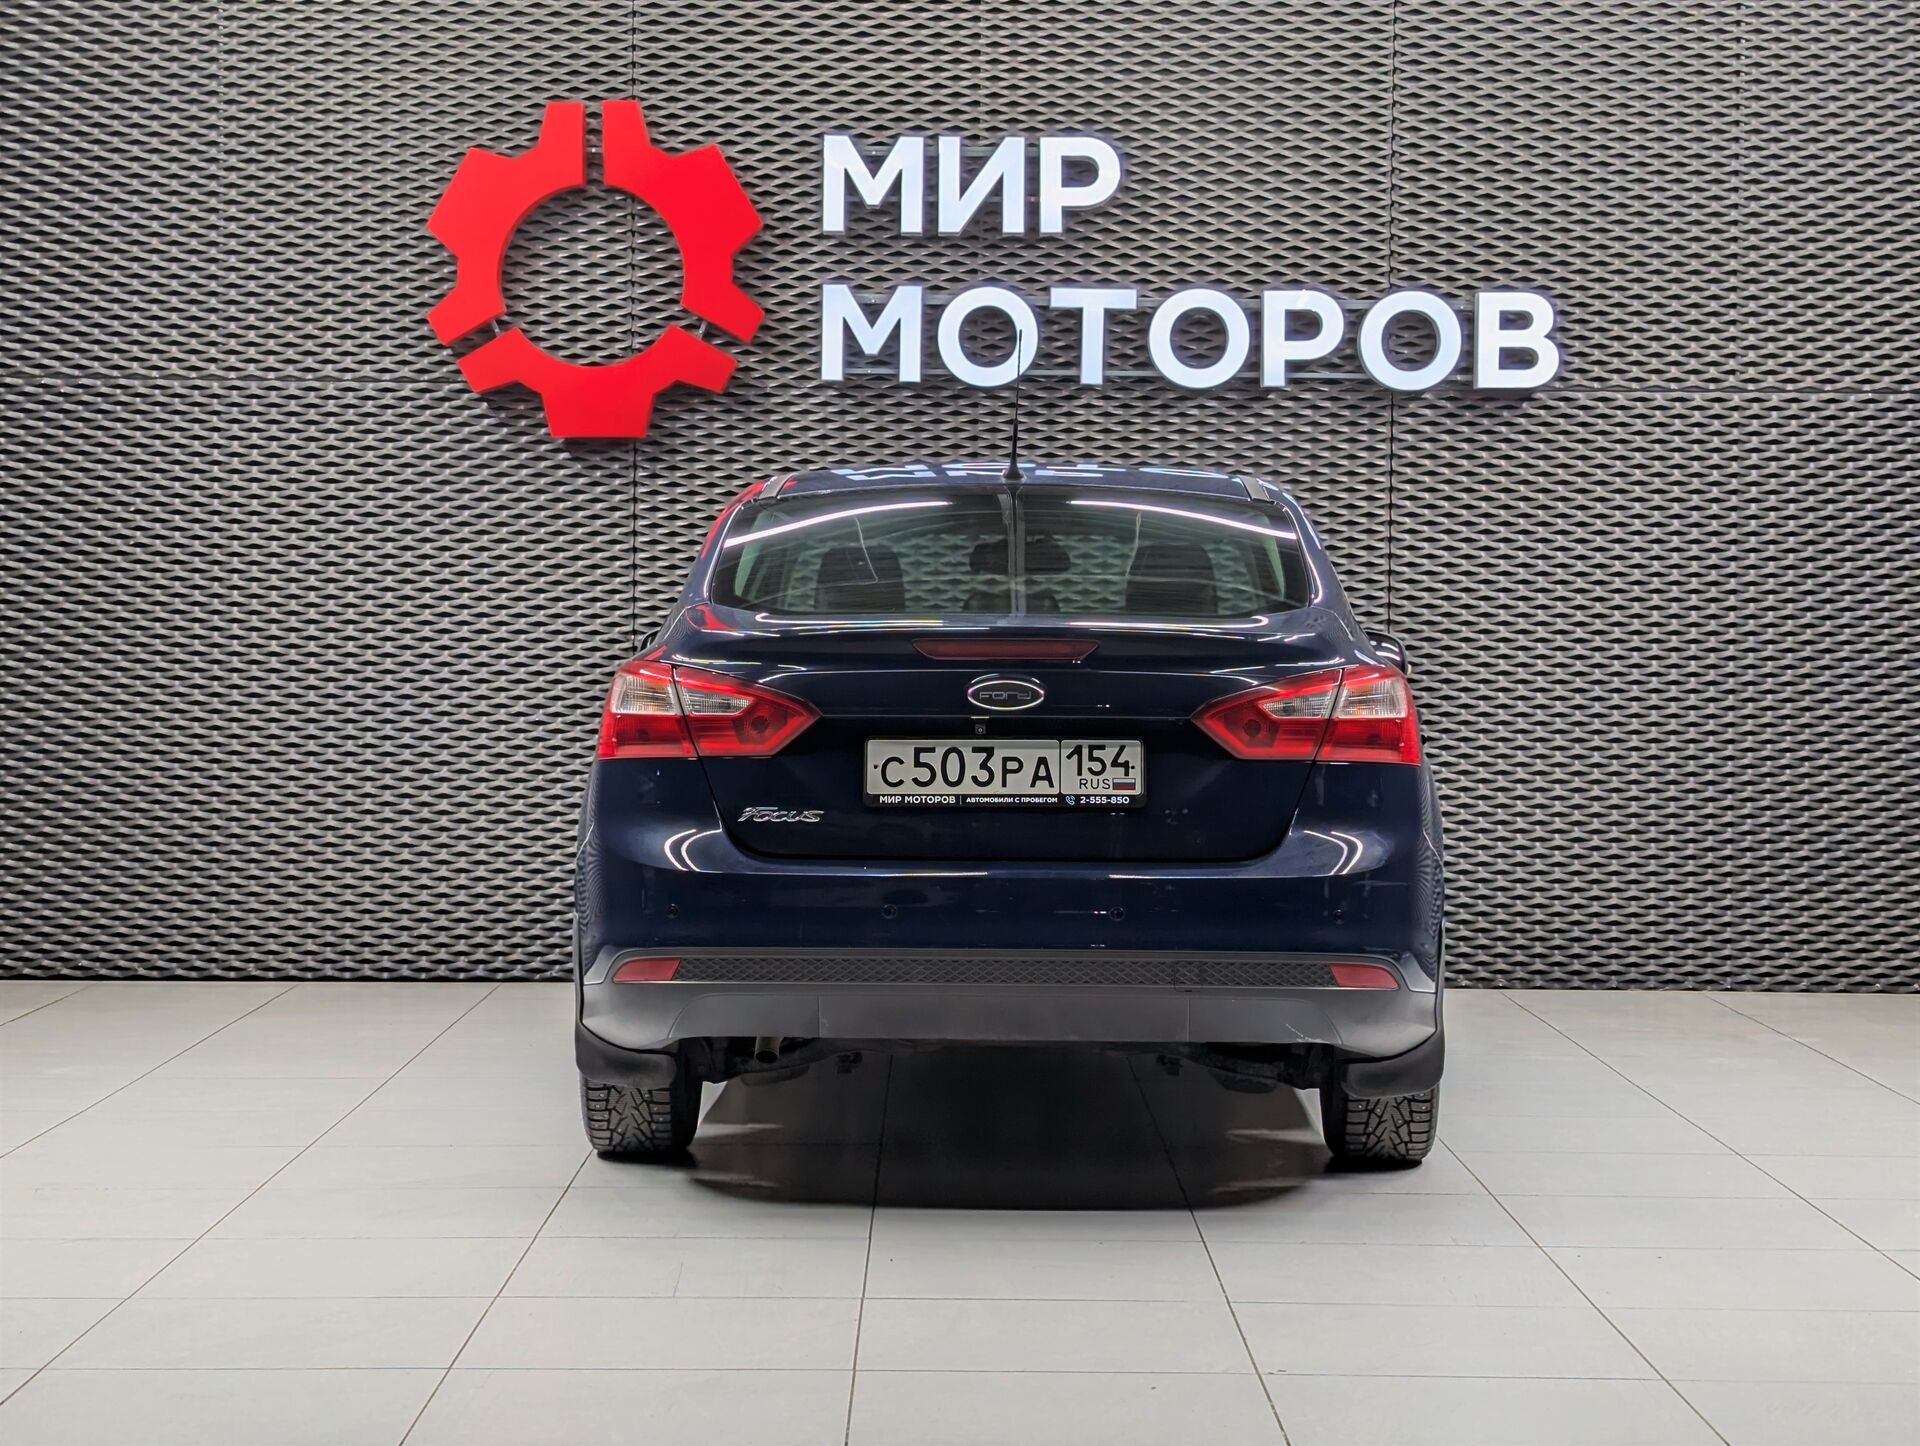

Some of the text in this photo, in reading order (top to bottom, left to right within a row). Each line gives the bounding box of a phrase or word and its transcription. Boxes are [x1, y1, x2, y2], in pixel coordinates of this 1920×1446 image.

[822, 134, 1122, 236] МИР
[820, 284, 1561, 391] МОТОРОВ
[1065, 744, 1130, 777] 154
[1079, 778, 1111, 790] RUS
[879, 795, 956, 803] МИР МОТОРОВ
[1080, 796, 1130, 804] 2-555-850
